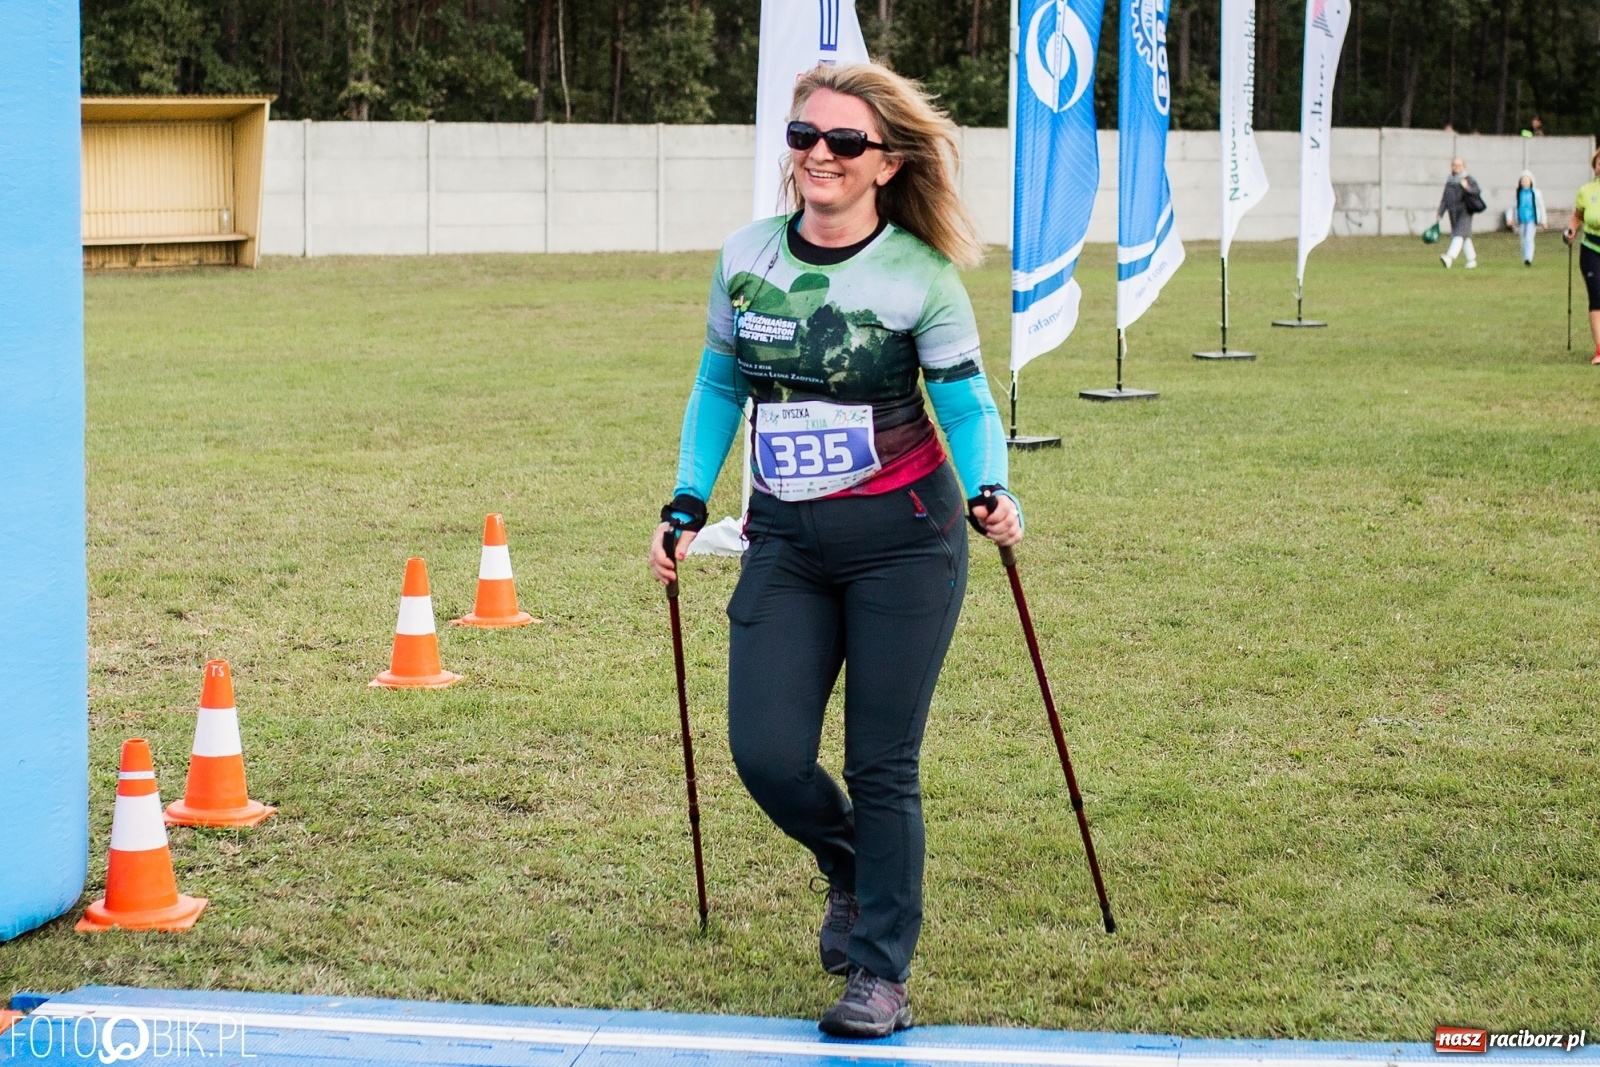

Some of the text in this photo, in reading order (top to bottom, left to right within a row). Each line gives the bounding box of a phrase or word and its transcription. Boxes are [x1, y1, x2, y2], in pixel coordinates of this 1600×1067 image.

[782, 408, 810, 419] DYSZKA
[812, 419, 828, 429] KIJA
[771, 433, 854, 476] 335
[211, 665, 224, 677] TS
